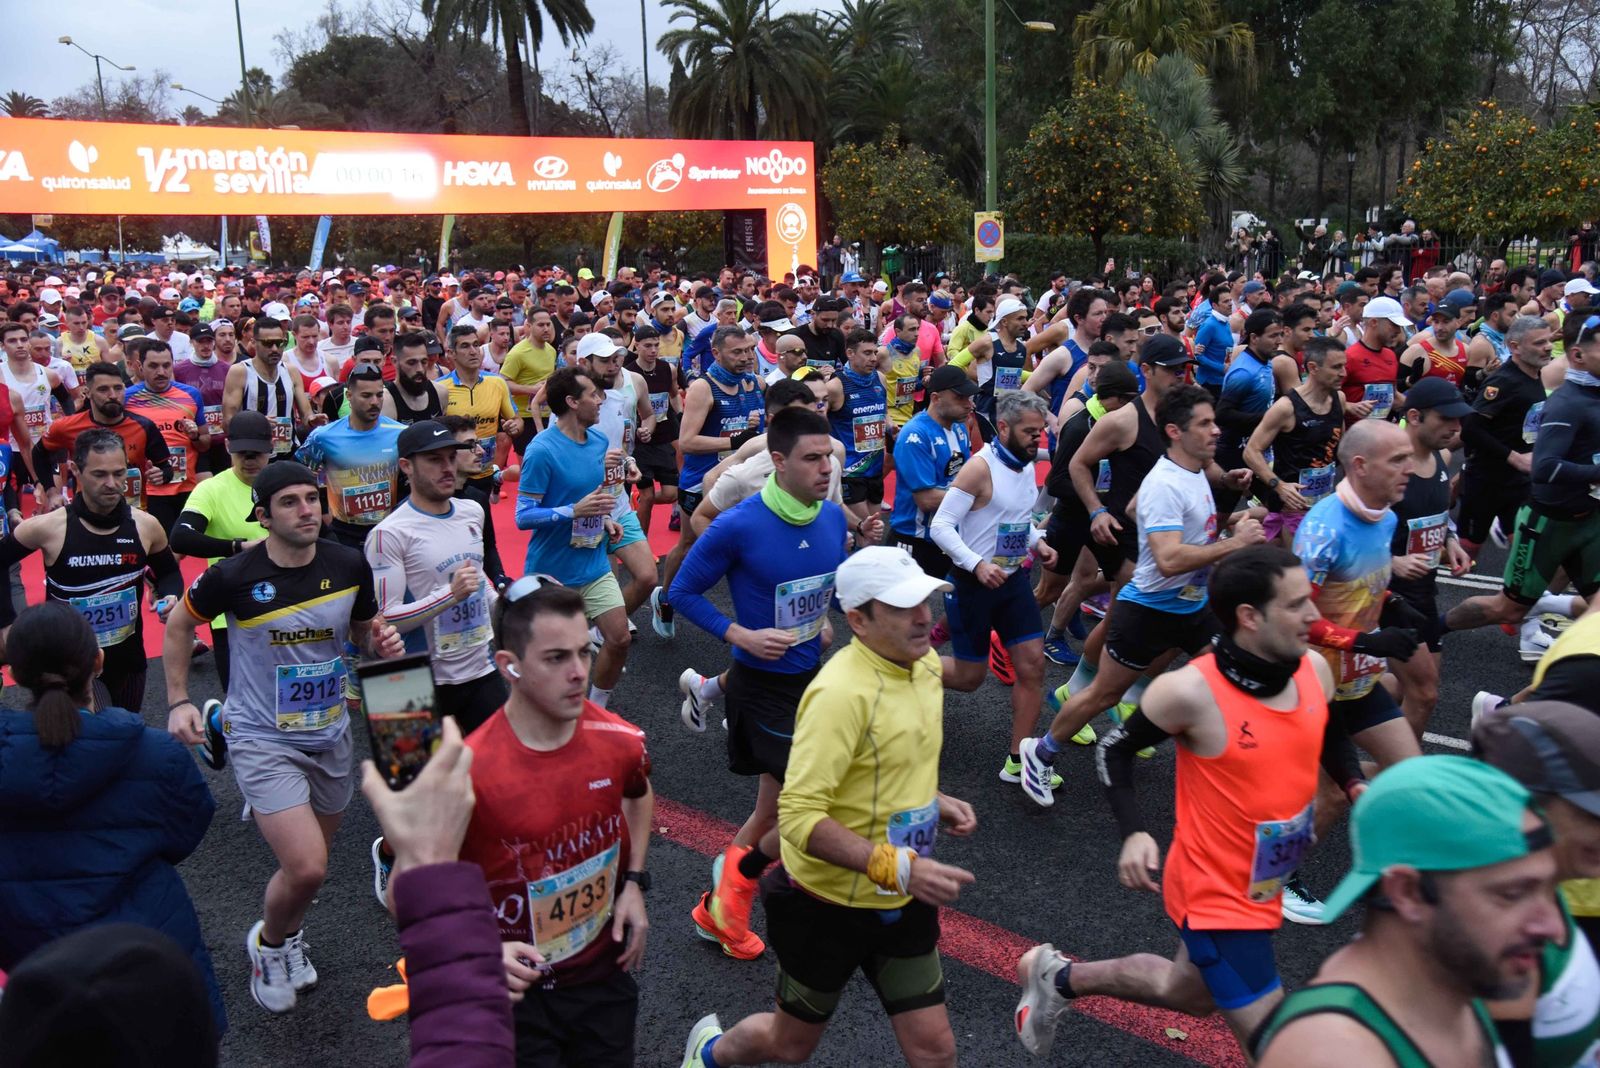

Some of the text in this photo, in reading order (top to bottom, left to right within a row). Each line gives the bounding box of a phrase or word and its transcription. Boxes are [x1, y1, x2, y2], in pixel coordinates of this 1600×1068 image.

[0, 150, 34, 182] A
[176, 145, 307, 171] maratón
[443, 160, 516, 186] HOKA
[687, 165, 742, 182] Sprinter
[527, 179, 577, 191] HYUNDAI
[744, 217, 754, 252] FINISH
[853, 403, 885, 415] enerplus
[864, 423, 880, 436] 961
[355, 492, 384, 509] 1112
[82, 604, 124, 625] 2251
[289, 677, 337, 702] 2912
[588, 778, 613, 790] HOKA
[549, 874, 606, 922] 4733
